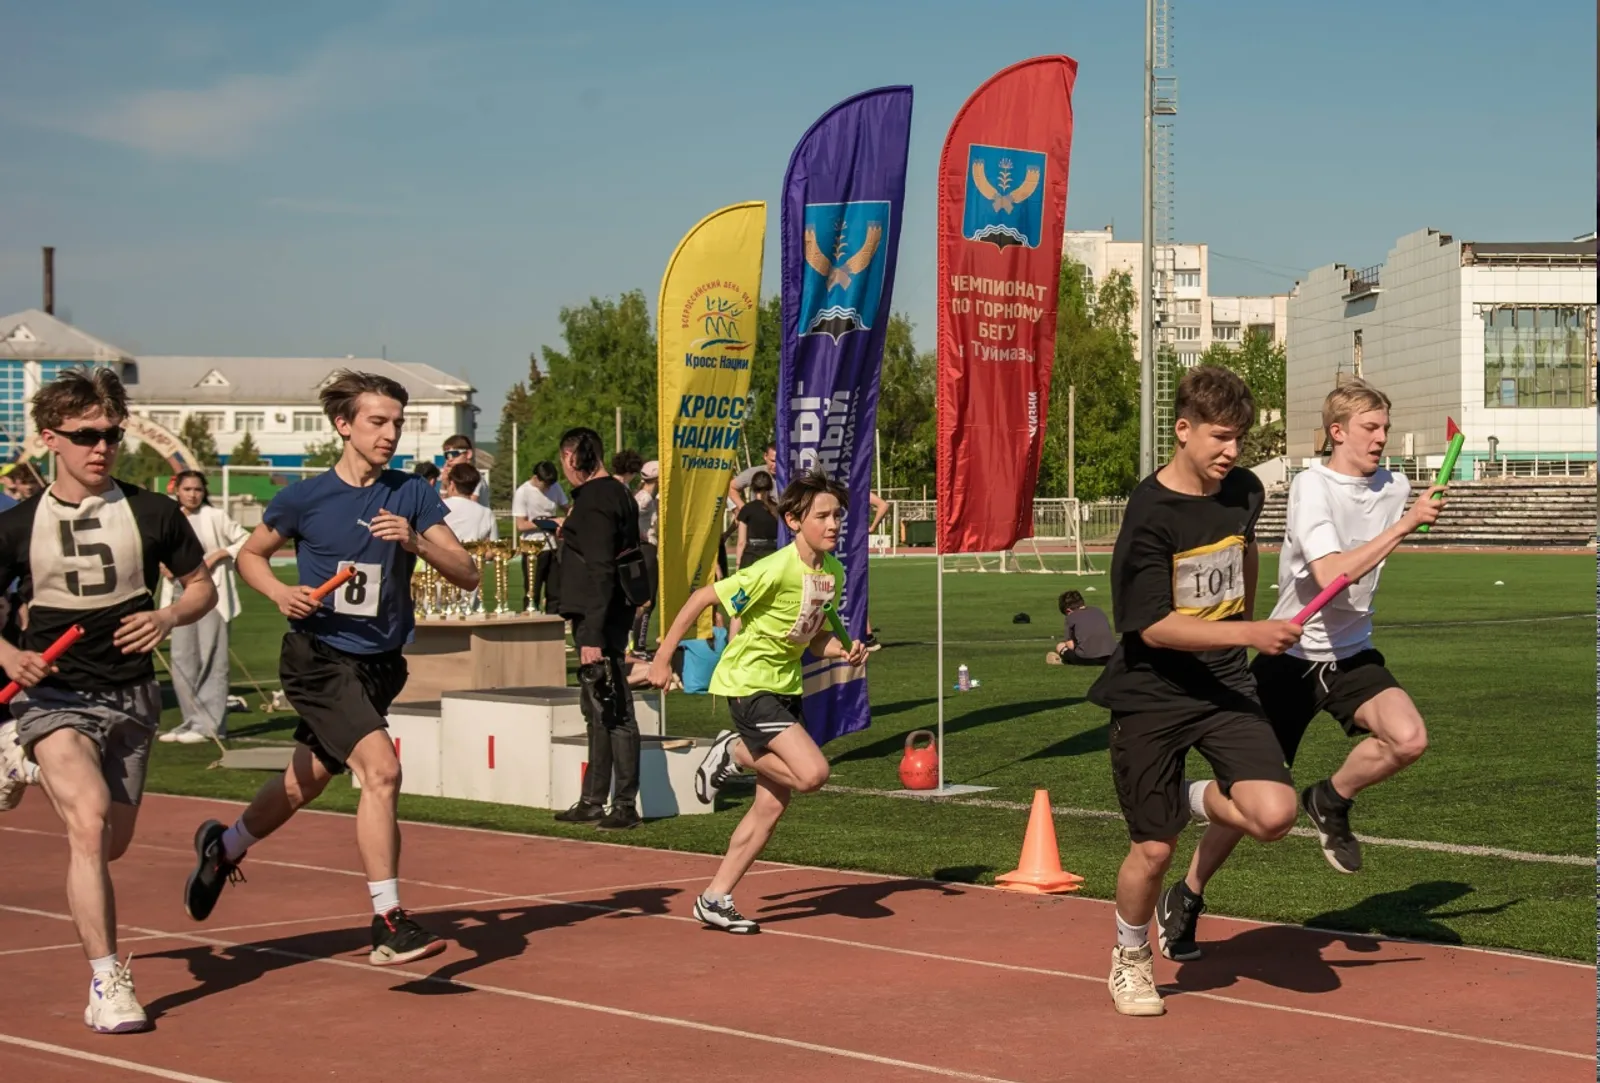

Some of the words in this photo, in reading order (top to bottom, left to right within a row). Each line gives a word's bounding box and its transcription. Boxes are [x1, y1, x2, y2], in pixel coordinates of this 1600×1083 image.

[951, 275, 1048, 302] ЧЕМПИОНАТ
[682, 279, 721, 329] ВСЕРОССИЙСКИЙ
[723, 281, 740, 293] ДЕНЬ
[952, 297, 970, 314] ПО
[976, 299, 1044, 323] ГОРНОМУ
[979, 321, 1016, 341] БЕГУ
[685, 353, 718, 370] Кросс
[720, 356, 749, 371] Нации
[971, 340, 1036, 363] Туймазы
[679, 394, 745, 420] КРОСС
[673, 421, 741, 452] НАЦИЙ
[682, 455, 733, 472] Туймазы
[59, 517, 118, 597] 5
[344, 570, 368, 606] 8
[1194, 564, 1235, 598] 101
